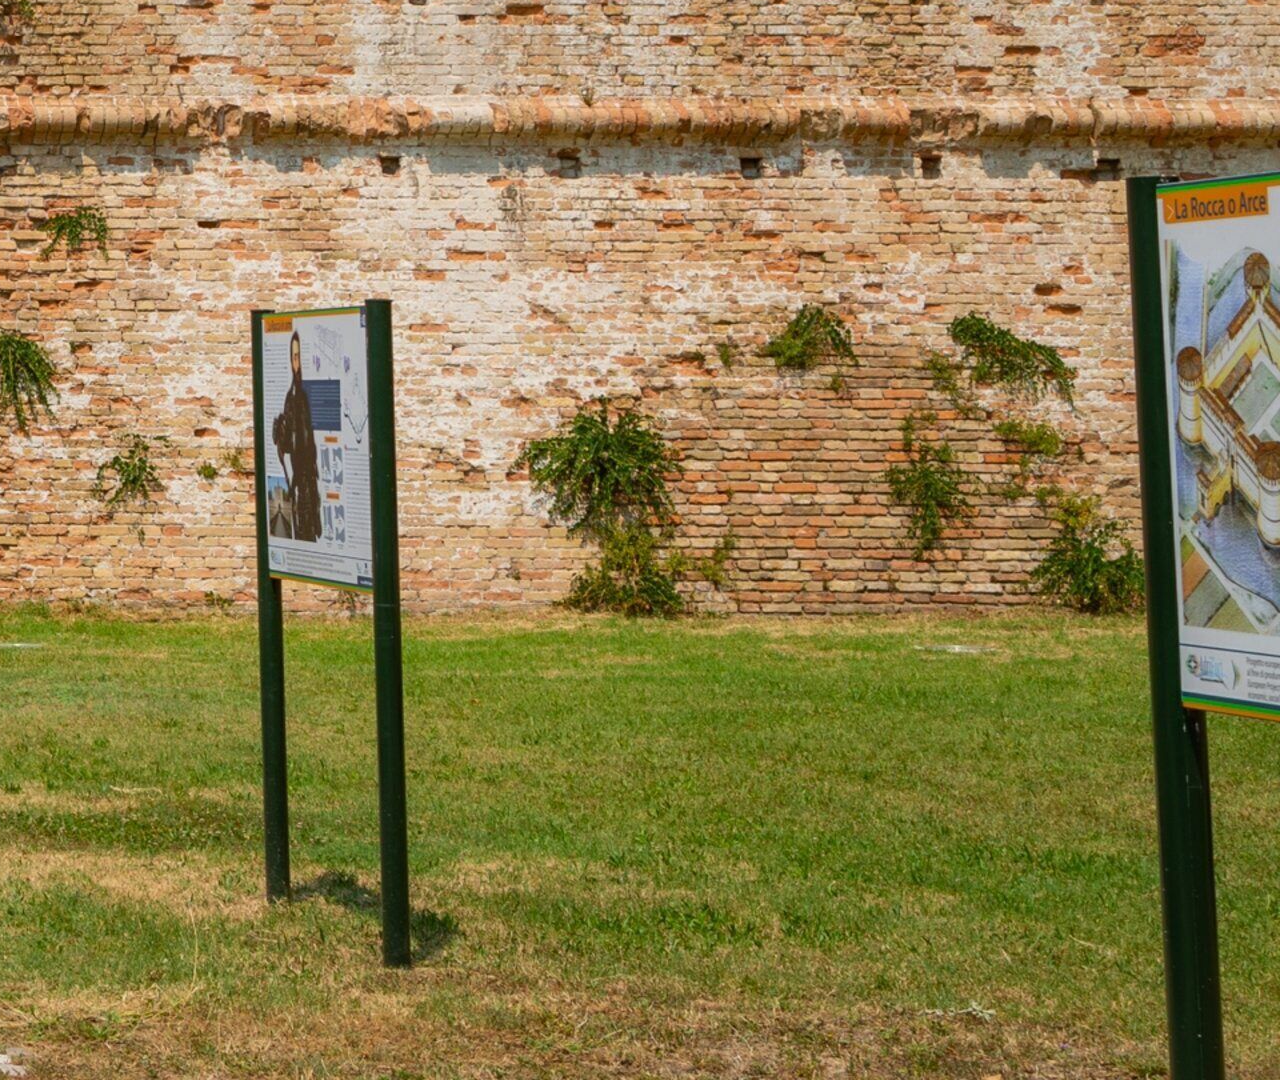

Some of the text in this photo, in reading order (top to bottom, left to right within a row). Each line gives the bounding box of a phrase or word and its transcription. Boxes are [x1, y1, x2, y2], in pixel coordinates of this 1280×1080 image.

[1174, 191, 1267, 219] La Rocca o Arce
